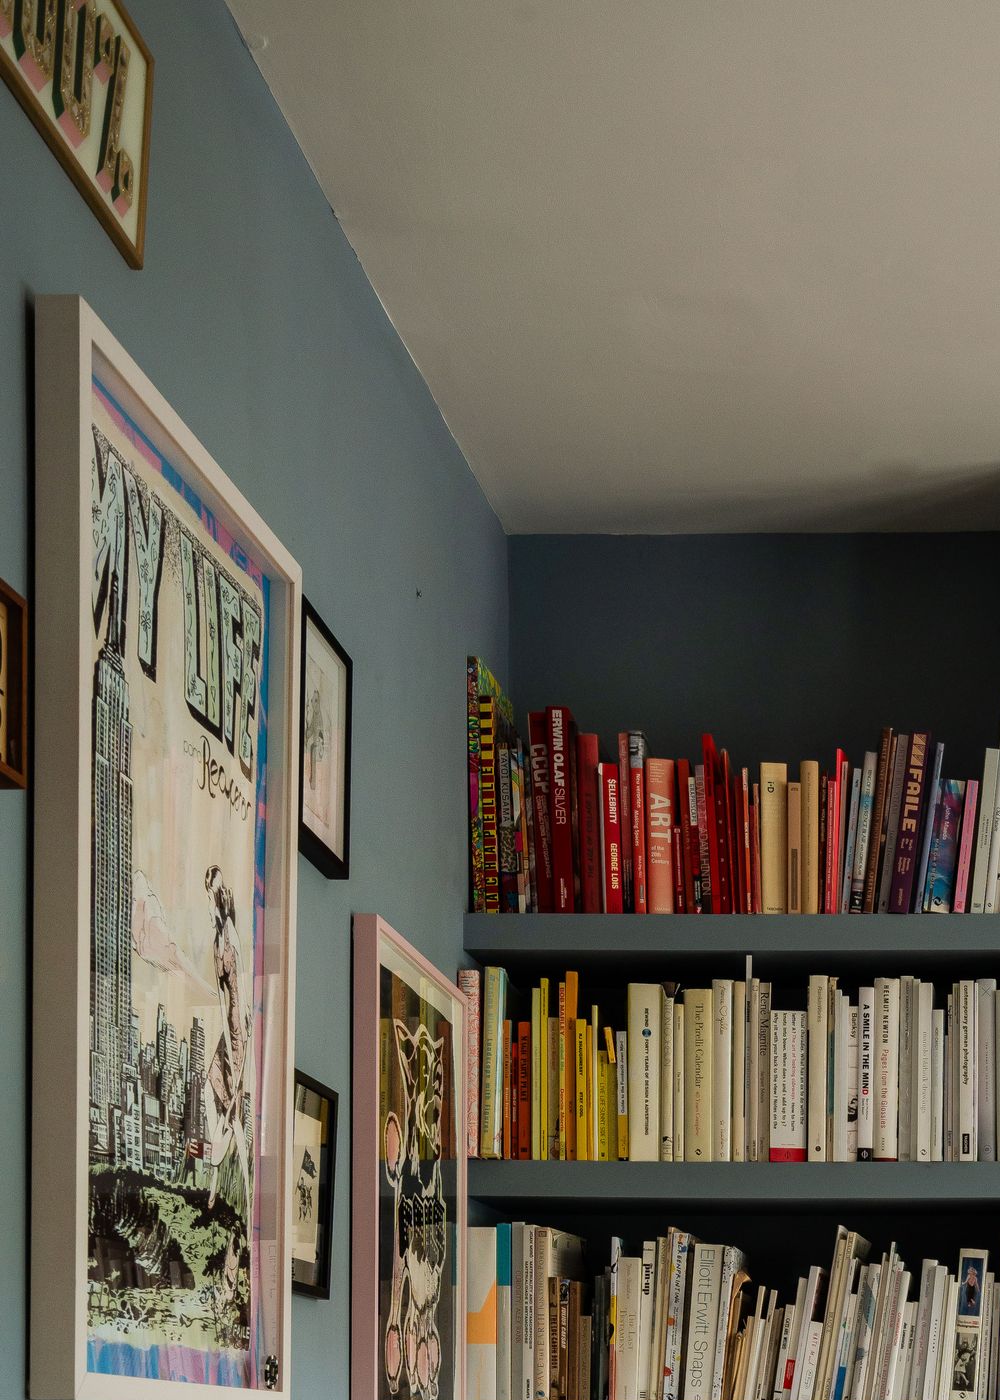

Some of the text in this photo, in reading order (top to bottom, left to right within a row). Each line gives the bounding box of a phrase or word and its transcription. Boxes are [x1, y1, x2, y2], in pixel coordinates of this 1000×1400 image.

[92, 423, 262, 783] MY LIFE
[500, 752, 511, 823] YAYOI KUSAMA
[530, 743, 549, 794] CCCP
[552, 709, 566, 825] ERWIN OLAF SILVER
[607, 778, 617, 824] $ELLEBRITY
[650, 792, 672, 844] ART
[902, 769, 922, 832] FAILE
[609, 843, 619, 890] GEORGE LOIS
[700, 858, 711, 896] HINTON
[695, 1003, 704, 1088] The Pirelli Calendar
[758, 991, 770, 1056] René Magritte
[849, 1012, 858, 1038] Banksy
[862, 1012, 870, 1040] SMILE
[862, 1042, 870, 1051] IN
[961, 985, 970, 1085] contemporary german photography
[862, 1053, 870, 1069] THE
[880, 984, 890, 1128] HELMUT NEWTON Pages from the Glossies
[862, 1072, 870, 1095] MIND
[919, 1084, 928, 1113] drawings
[642, 1263, 653, 1295] pin-up
[674, 1241, 684, 1304] SCREENPRINTING
[537, 1313, 545, 1346] EARTH
[618, 1309, 627, 1354] TESTAMENT
[627, 1313, 636, 1350] THE LAST
[690, 1248, 714, 1387] Elliott Erwitt Snaps
[537, 1363, 545, 1386] SAVE
[550, 1355, 558, 1369] BOOK
